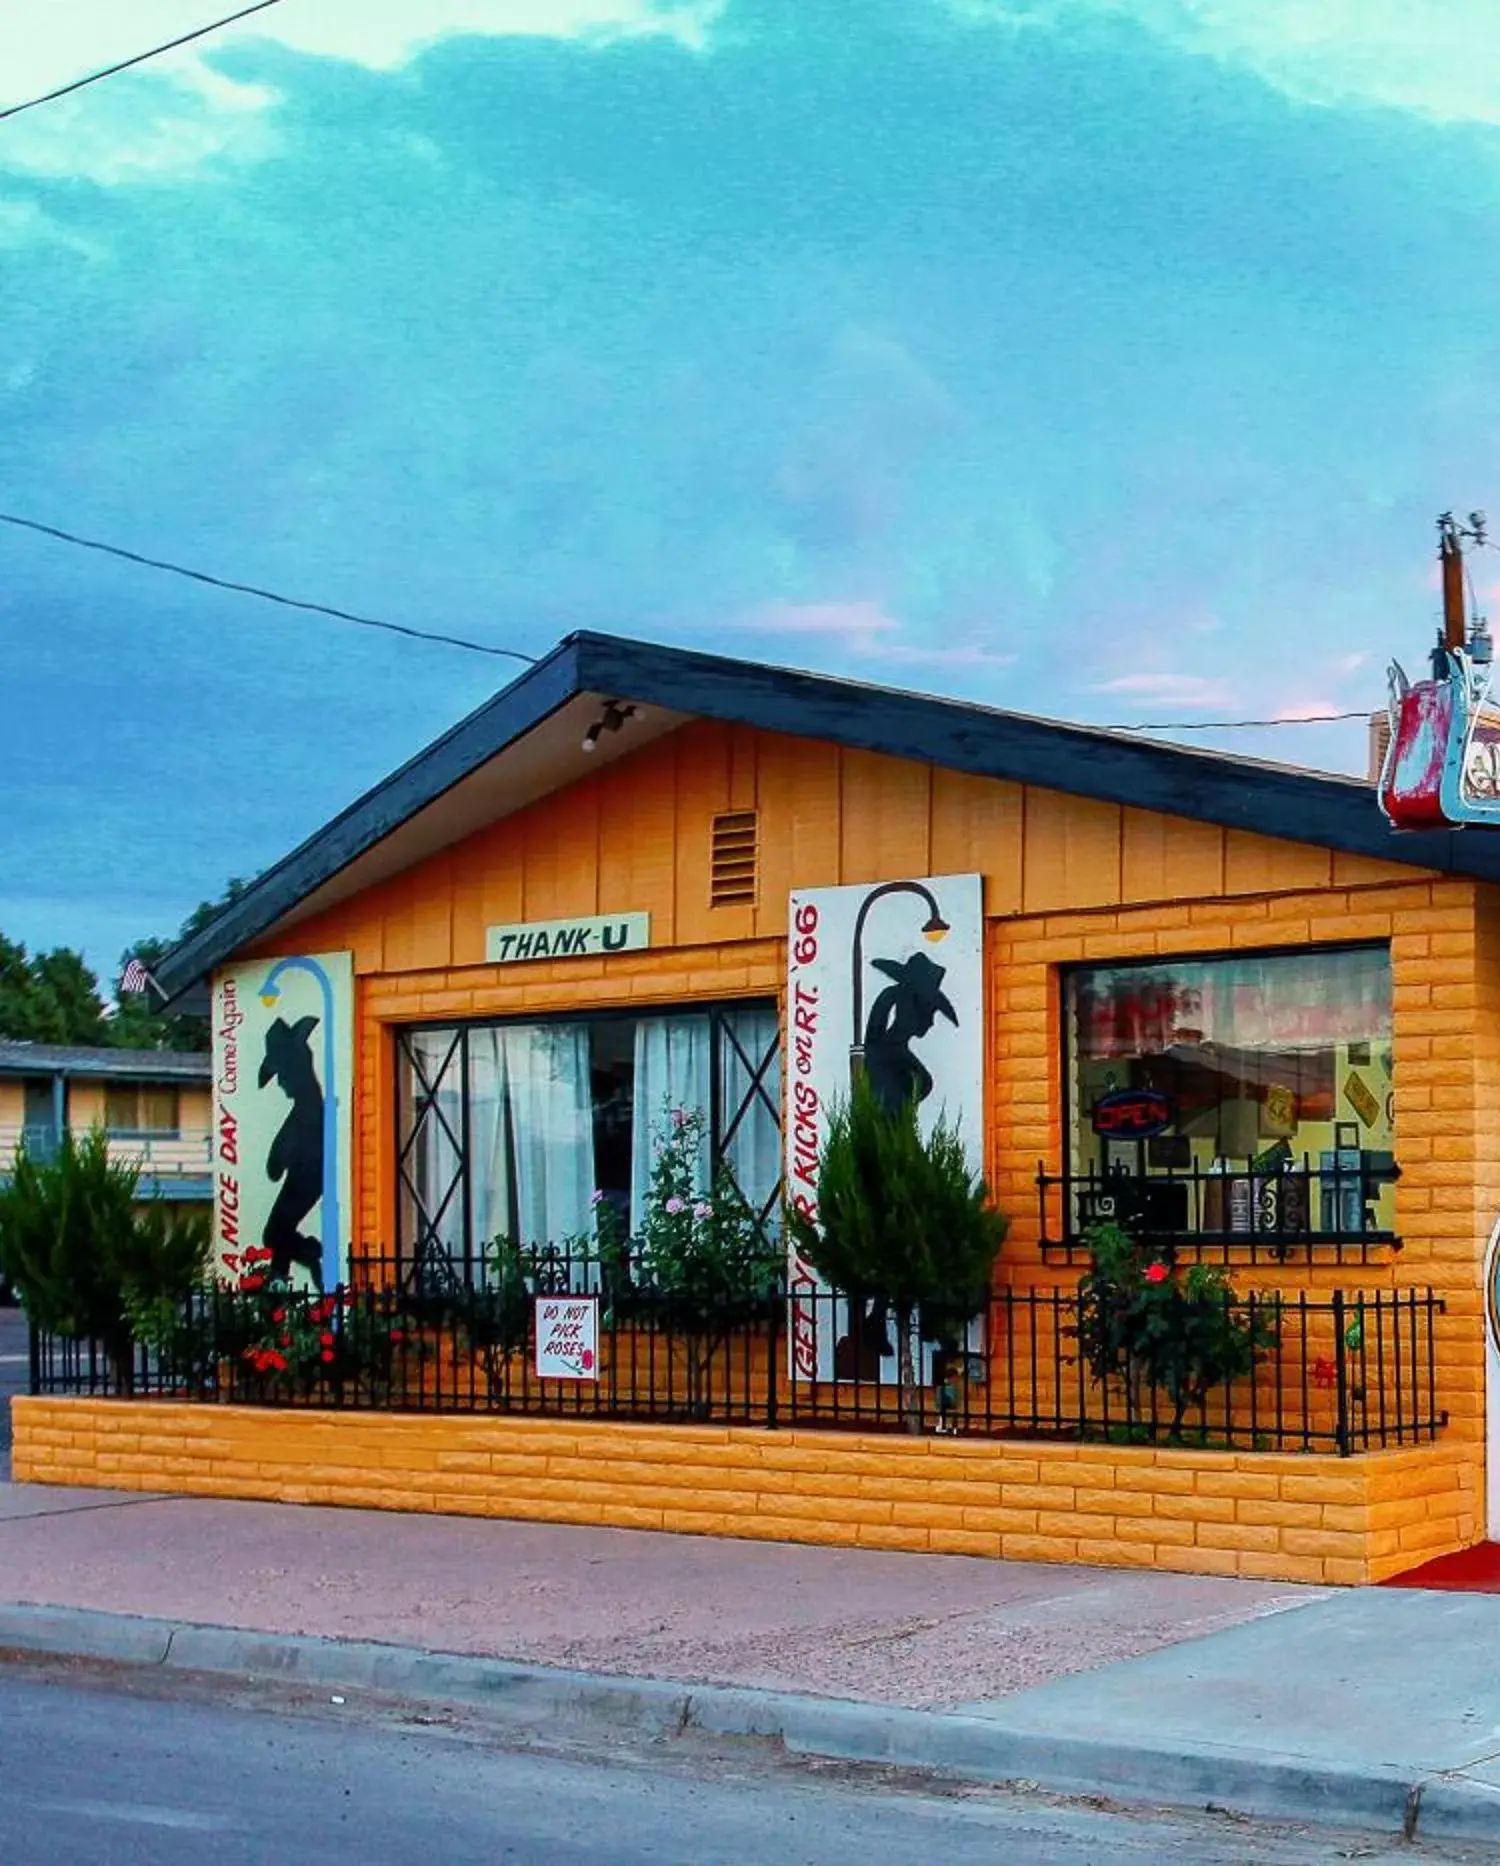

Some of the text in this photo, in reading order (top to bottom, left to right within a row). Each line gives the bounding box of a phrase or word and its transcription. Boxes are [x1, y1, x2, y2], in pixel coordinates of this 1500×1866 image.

[794, 980, 818, 1034] RT.
[218, 979, 243, 1094] Come Again
[794, 1081, 817, 1188] KICKS
[1095, 1101, 1168, 1129] OPEN
[220, 1172, 239, 1246] NICE
[222, 1253, 239, 1273] A
[543, 1305, 591, 1320] DO NOT
[550, 1323, 583, 1338] PICK
[543, 1341, 585, 1356] ROSES
[794, 1292, 818, 1378] GET
